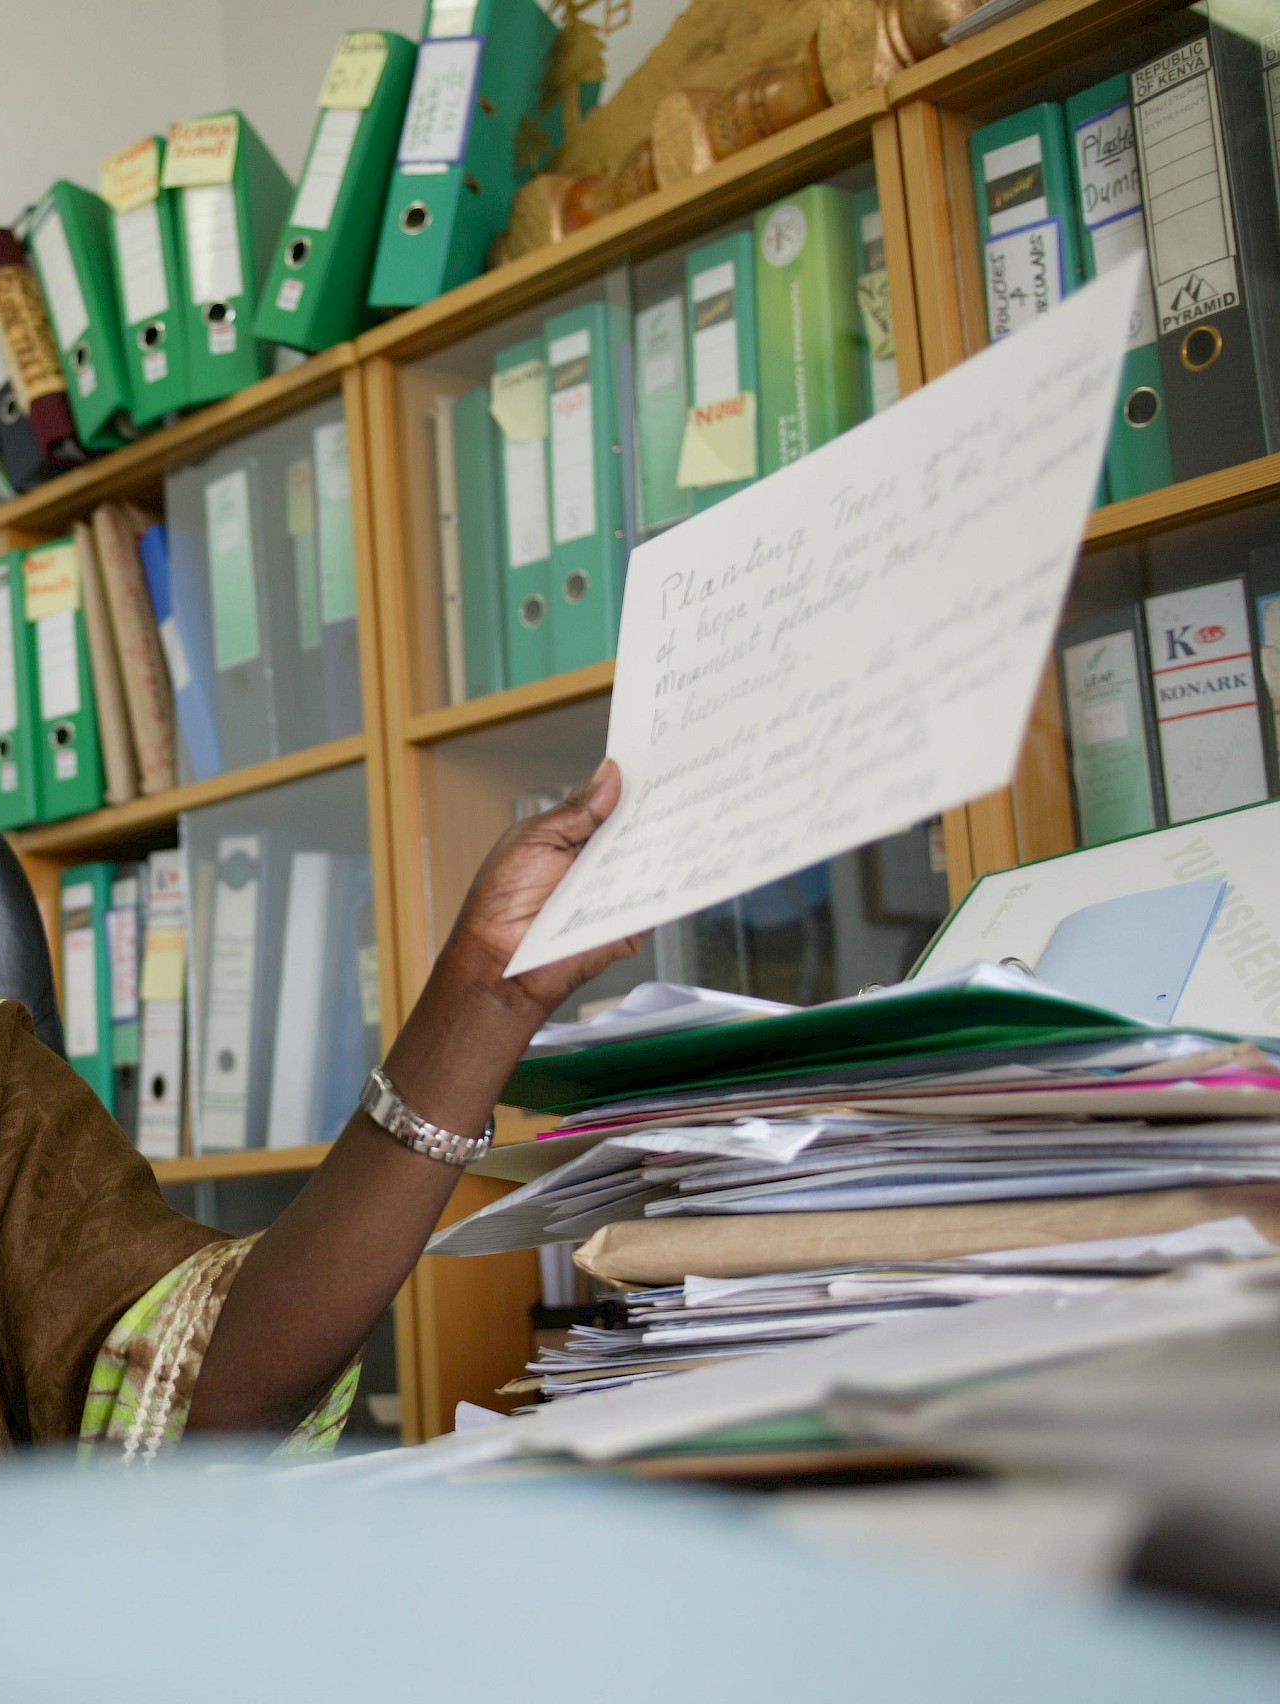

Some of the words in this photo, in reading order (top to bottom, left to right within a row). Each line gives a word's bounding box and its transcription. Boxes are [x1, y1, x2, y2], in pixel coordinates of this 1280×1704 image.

[1135, 42, 1203, 85] REPUBLIC
[1136, 81, 1154, 98] OF
[1158, 56, 1205, 86] KENYA
[1029, 232, 1049, 315] IRCULARS
[1162, 292, 1236, 332] PYRAMID
[660, 527, 807, 621] Planting
[829, 475, 898, 530] Trees
[656, 626, 679, 669] of
[695, 601, 749, 647] hope
[761, 556, 817, 609] and
[655, 620, 762, 698] Movement
[1164, 623, 1197, 660] K
[1083, 669, 1115, 689] LEAF
[1160, 673, 1249, 703] KONARK
[650, 708, 668, 746] to
